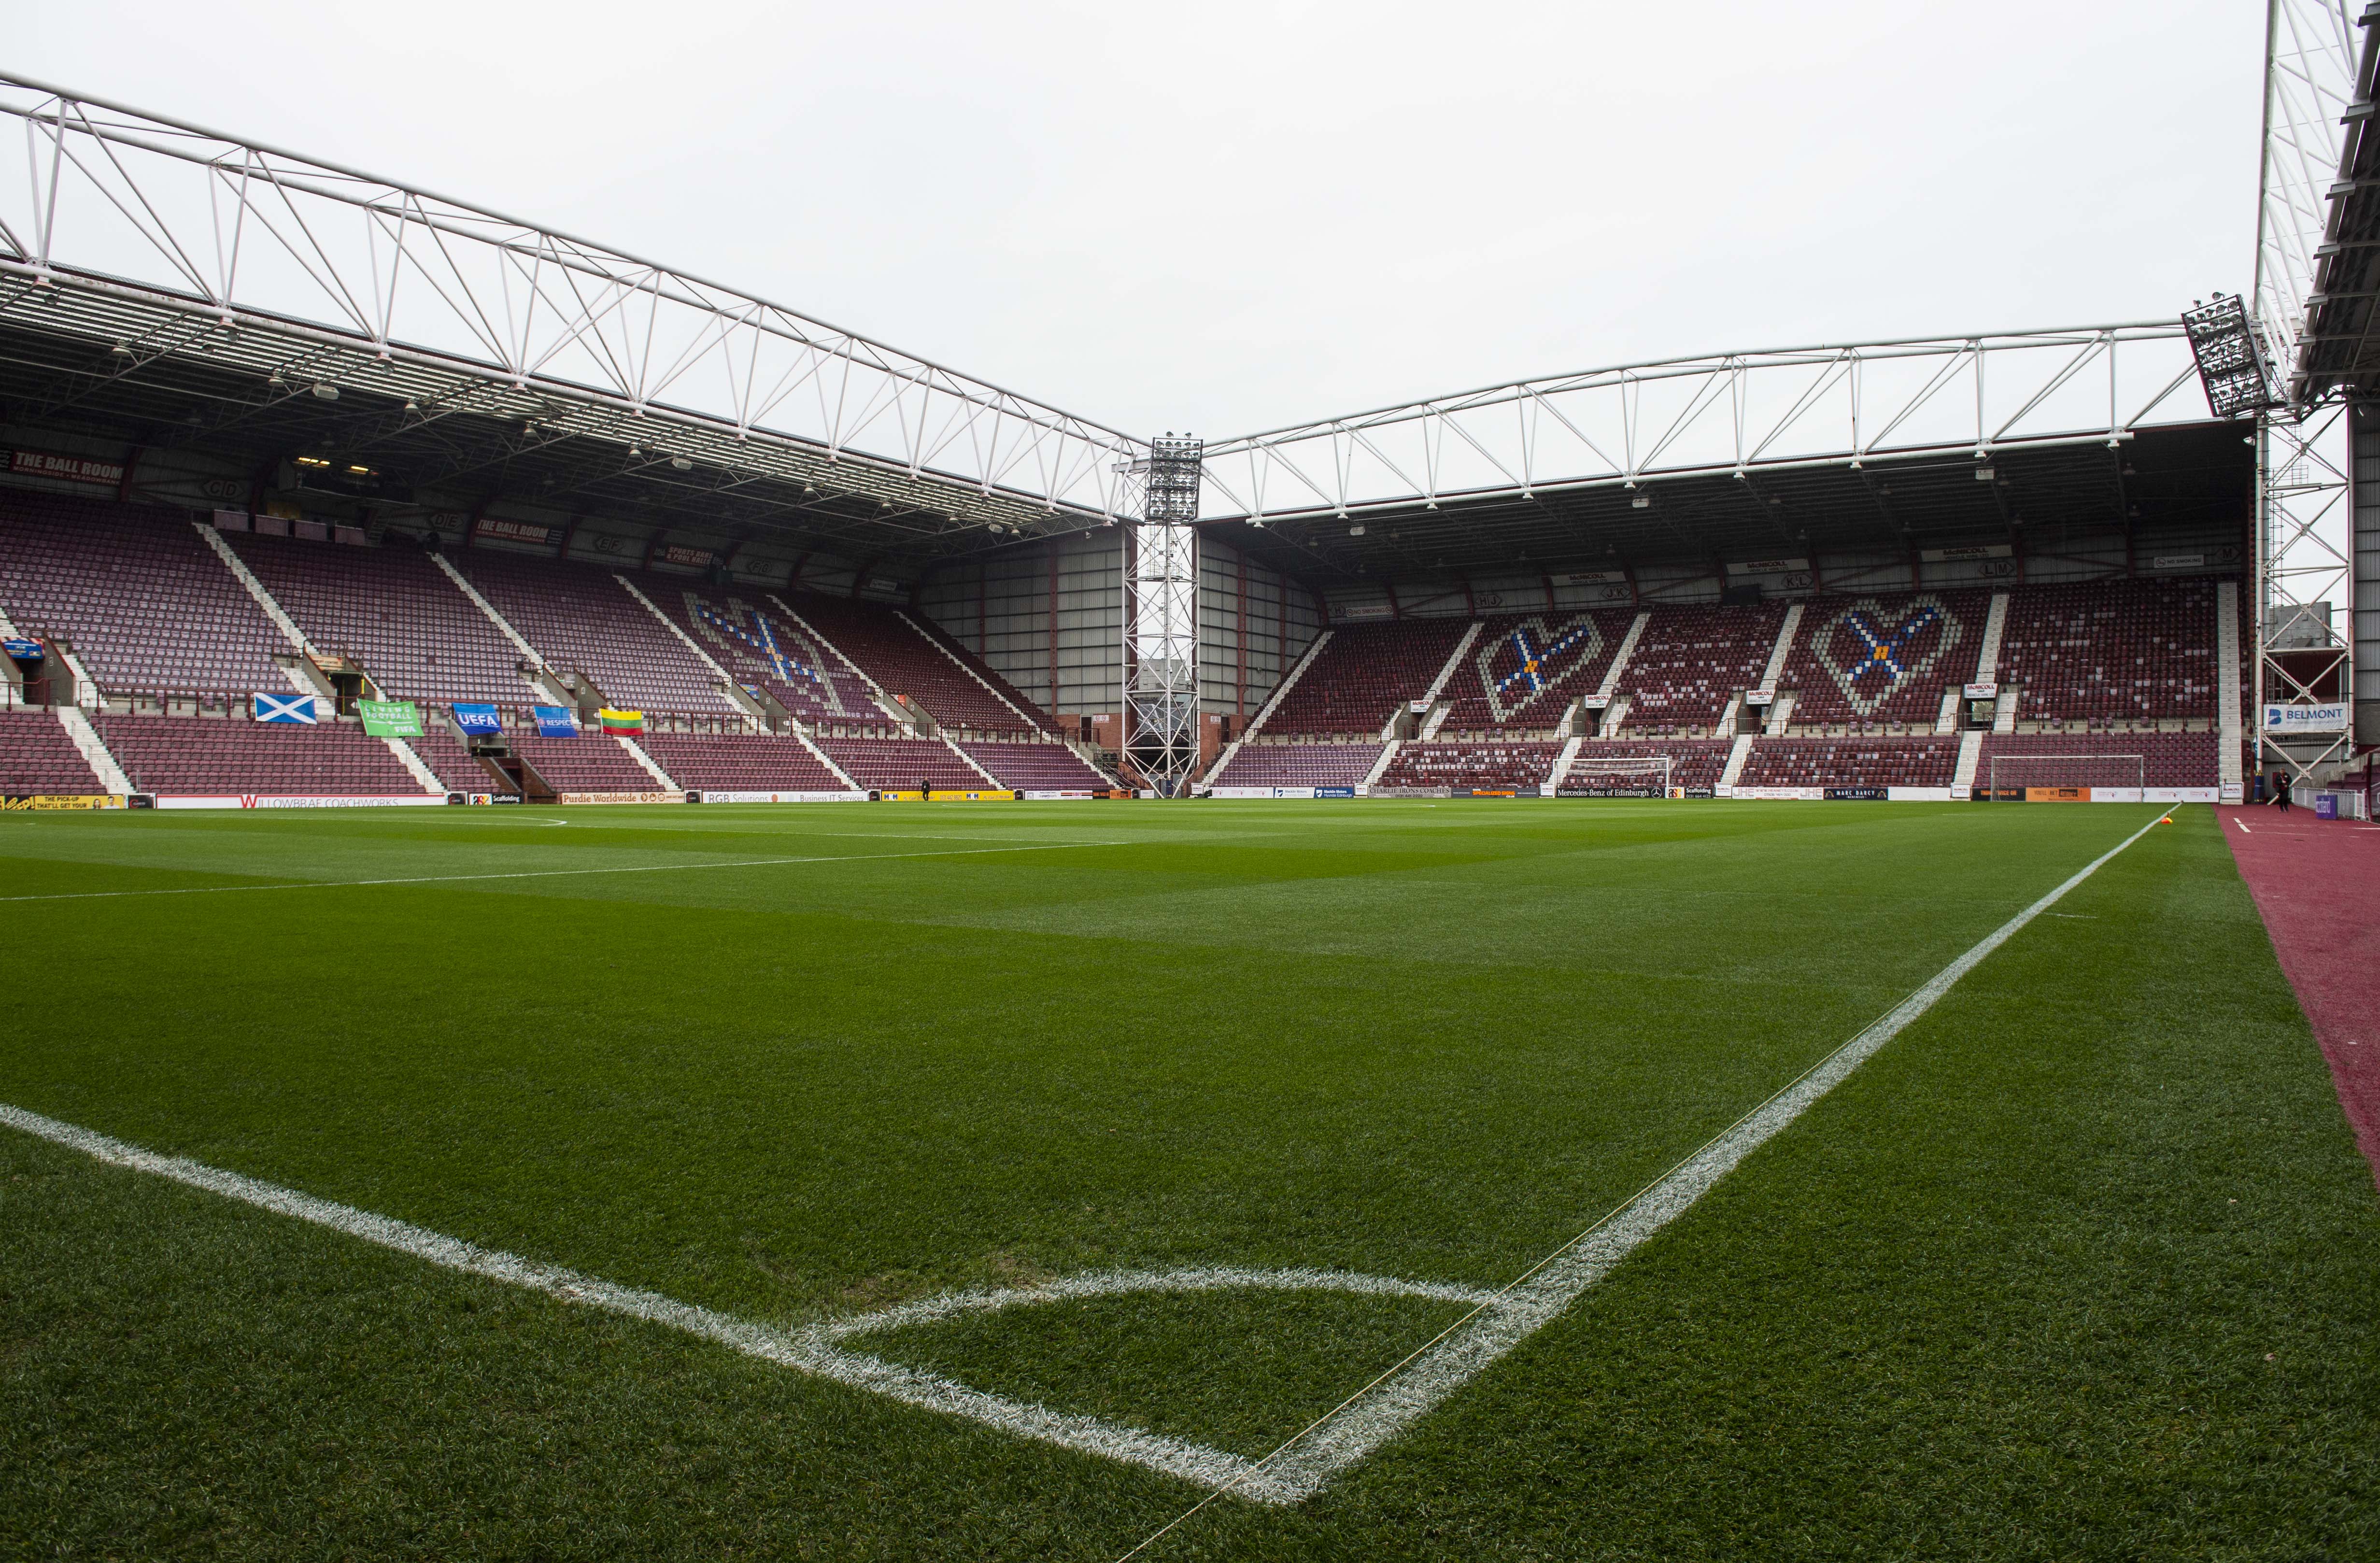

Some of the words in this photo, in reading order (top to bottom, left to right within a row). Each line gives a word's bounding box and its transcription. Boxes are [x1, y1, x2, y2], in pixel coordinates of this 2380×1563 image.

[15, 452, 43, 469] THE
[44, 456, 79, 473] BALL
[81, 462, 124, 480] ROOM
[13, 466, 65, 478] MORNINGSIDE
[70, 473, 121, 485] MEADOWBANK
[477, 519, 495, 532] THE
[496, 521, 518, 534] BALL
[519, 525, 549, 539] ROOM
[669, 546, 694, 557] SPORTS
[2286, 709, 2343, 719] BELMONT
[458, 714, 498, 726] UEFA
[1615, 789, 1649, 797] Edinburgh
[1733, 788, 1755, 796] JHE
[1800, 788, 1822, 797] JHE
[326, 798, 398, 808] COACHWORKS
[563, 793, 592, 804] Purdie
[594, 793, 637, 802] Worldwide
[708, 794, 730, 802] RGB
[733, 794, 768, 802] Solutions
